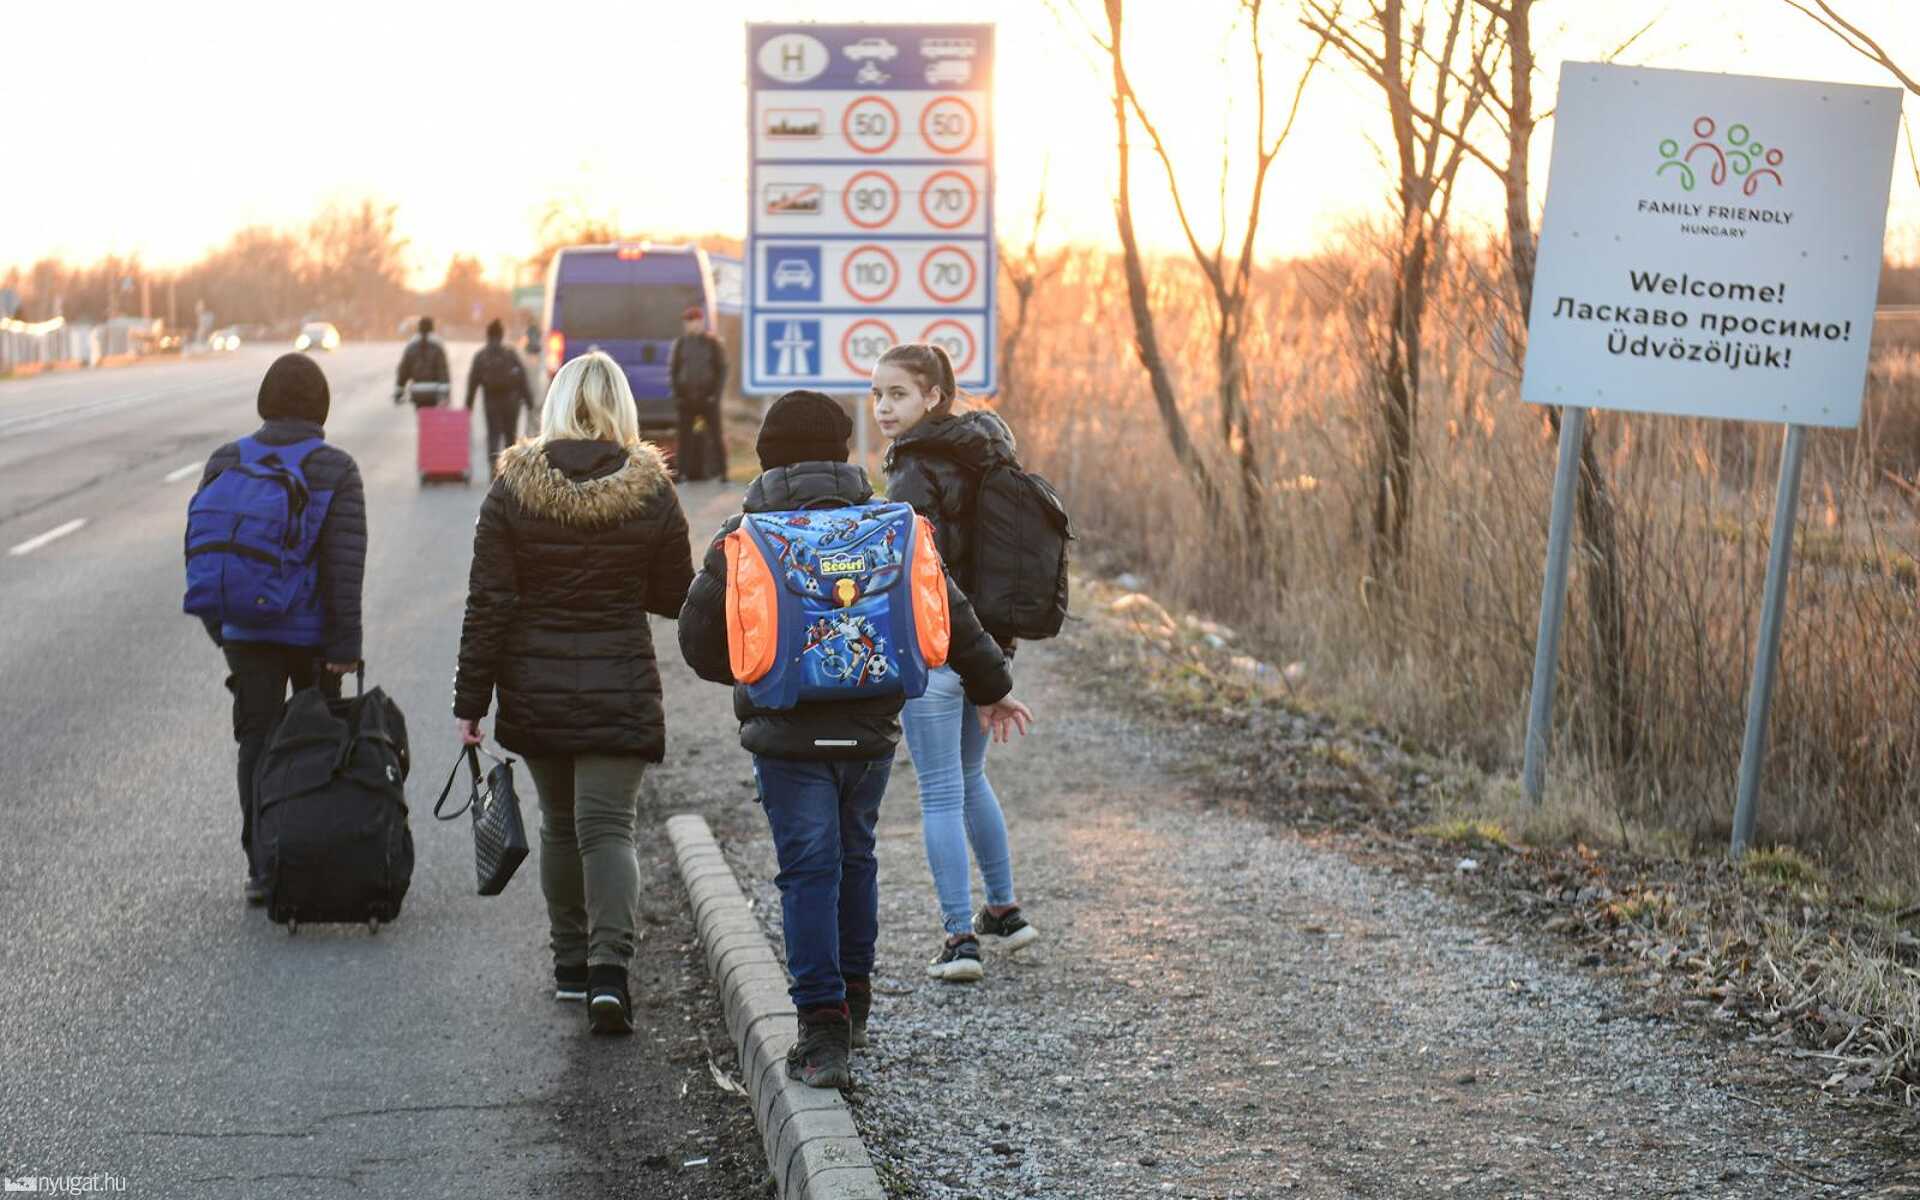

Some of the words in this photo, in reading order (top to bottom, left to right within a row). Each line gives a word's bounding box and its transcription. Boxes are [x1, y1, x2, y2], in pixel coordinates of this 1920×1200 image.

[780, 44, 806, 72] H
[855, 113, 887, 136] 50
[933, 113, 963, 136] 50
[854, 188, 887, 211] 90
[933, 188, 963, 211] 70
[1637, 199, 1702, 216] FAMILY
[1707, 205, 1794, 225] FRIENDLY
[1680, 223, 1747, 239] HUNGARY
[855, 263, 887, 286] 110
[933, 263, 963, 286] 70
[1629, 269, 1786, 304] Welcome!
[1552, 296, 1689, 328] Ласкаво
[1700, 313, 1852, 341] просимо!
[1607, 328, 1792, 370] Üdvözöljük!
[822, 559, 863, 572] Scout
